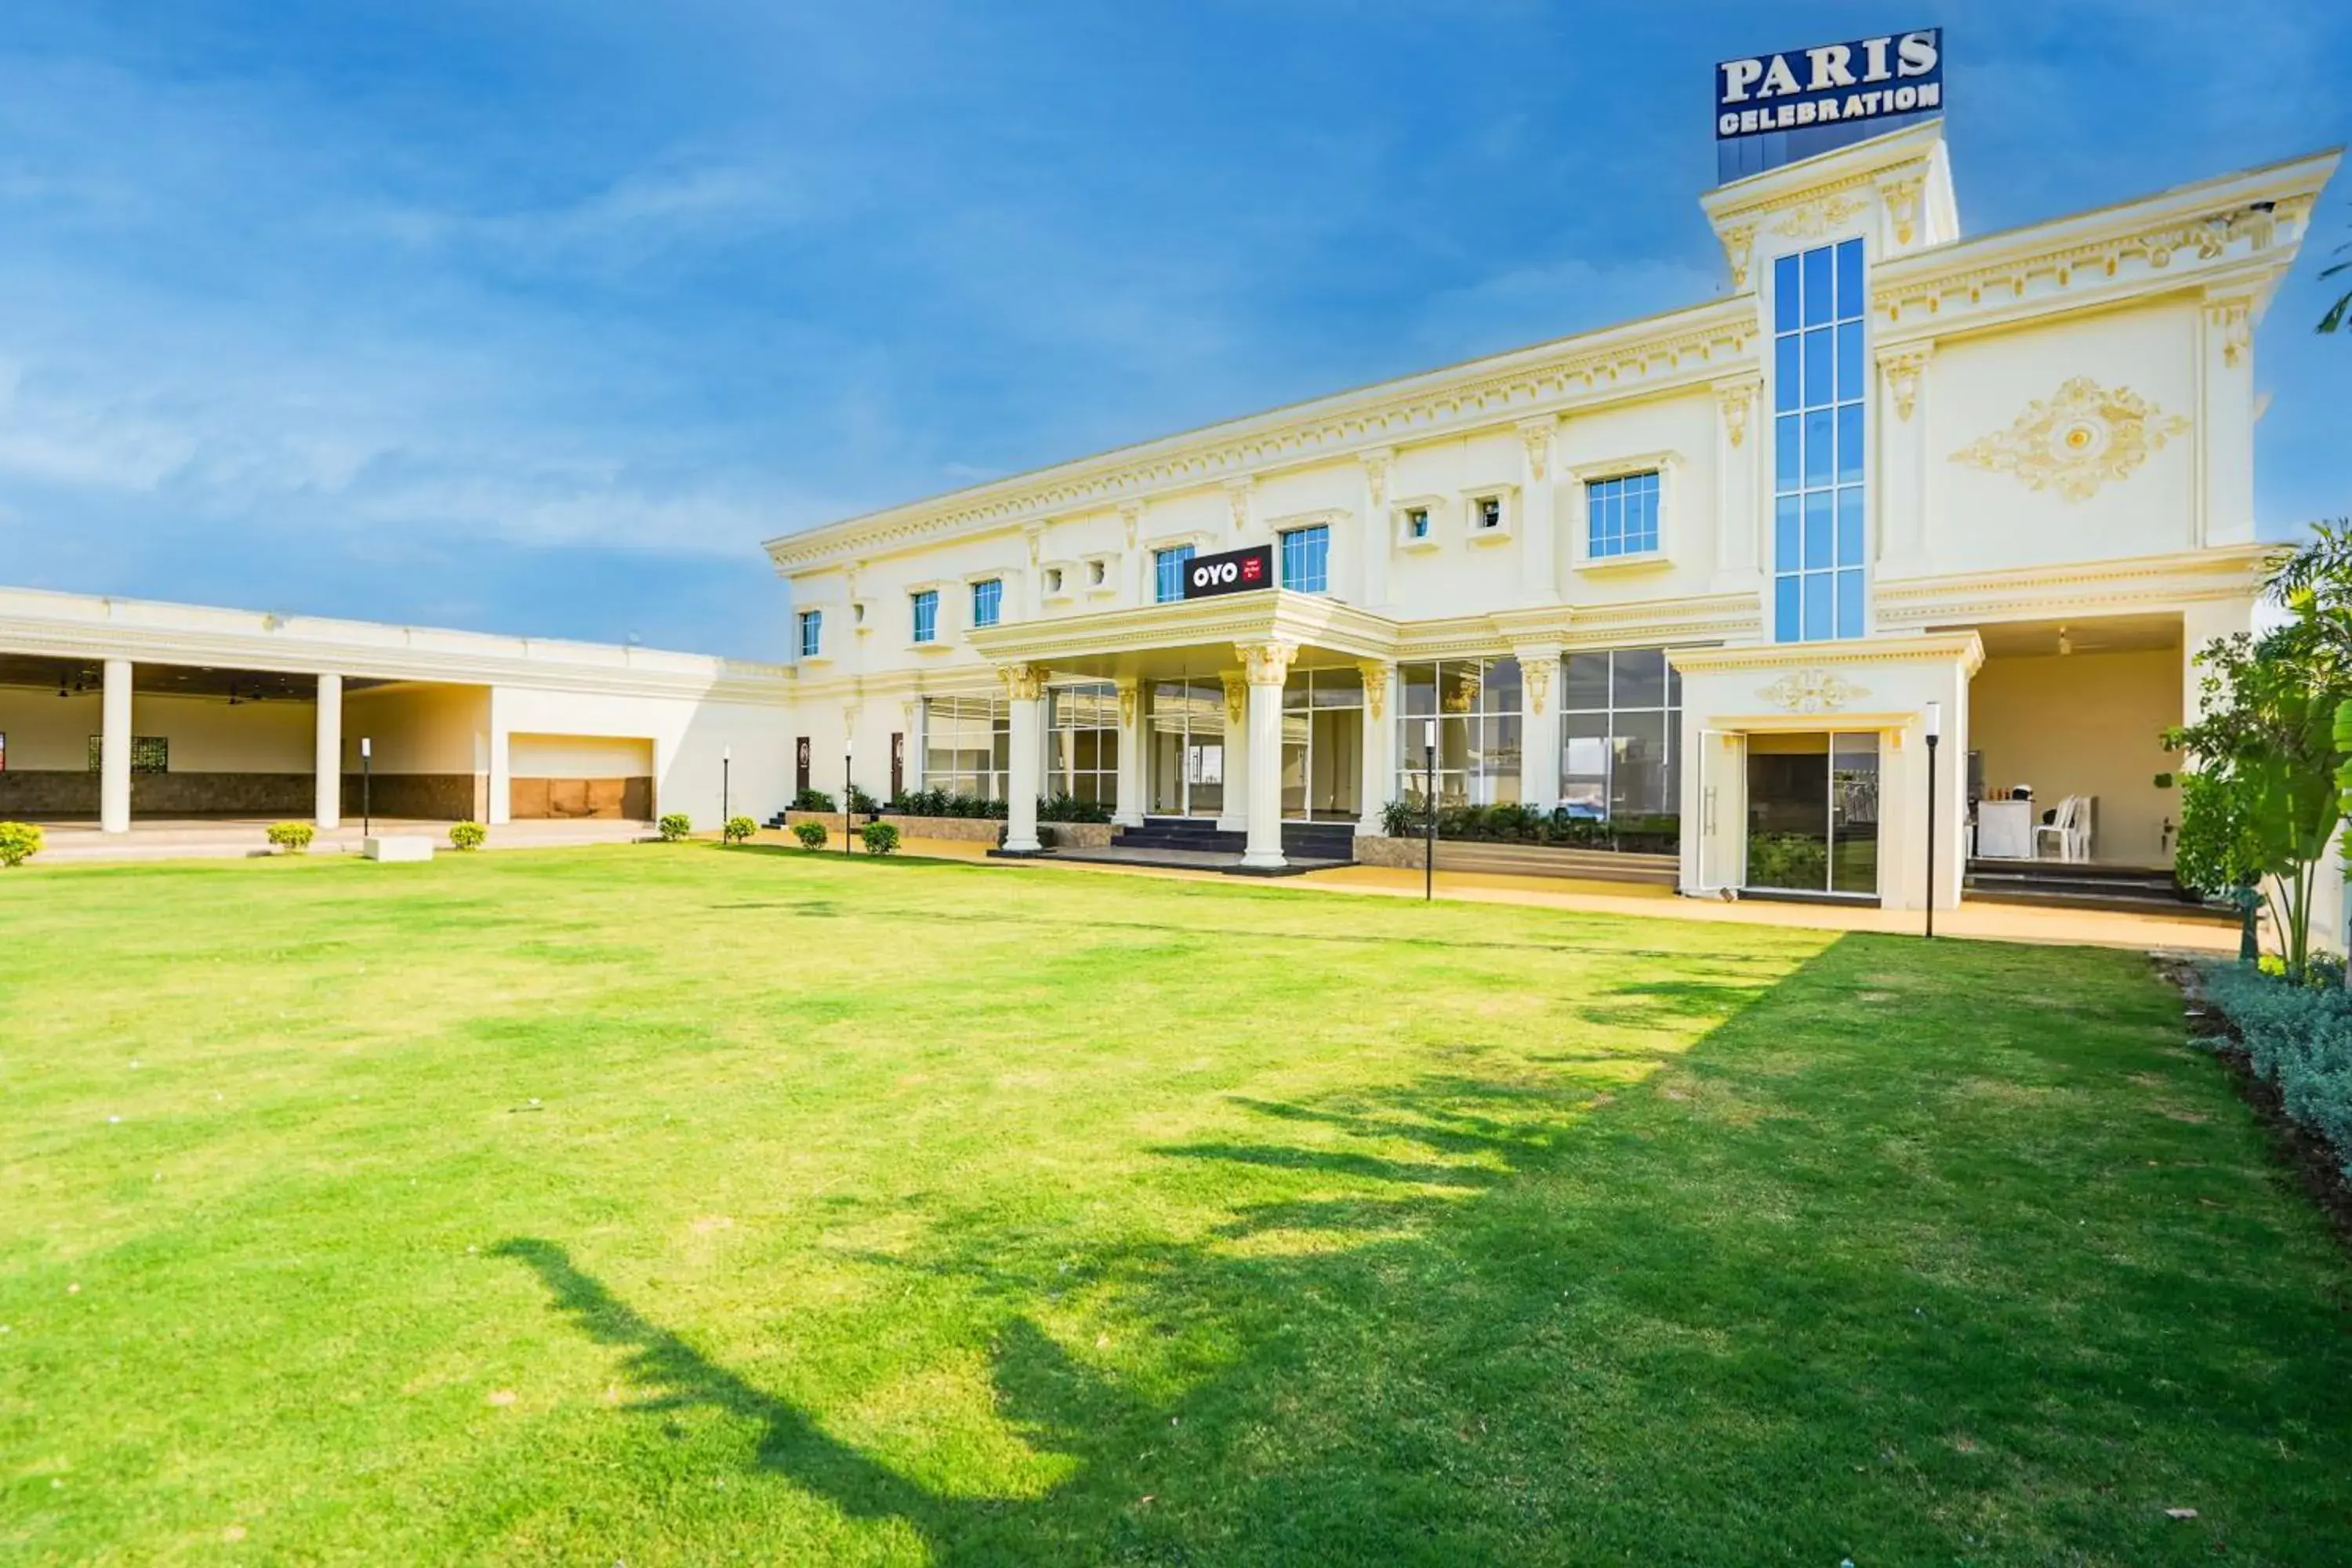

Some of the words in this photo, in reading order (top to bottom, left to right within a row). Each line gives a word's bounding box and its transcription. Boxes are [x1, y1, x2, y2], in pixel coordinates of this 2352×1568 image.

[1721, 30, 1938, 103] PARIS
[1719, 82, 1940, 135] CELEBRATION
[1193, 562, 1238, 587] OYO
